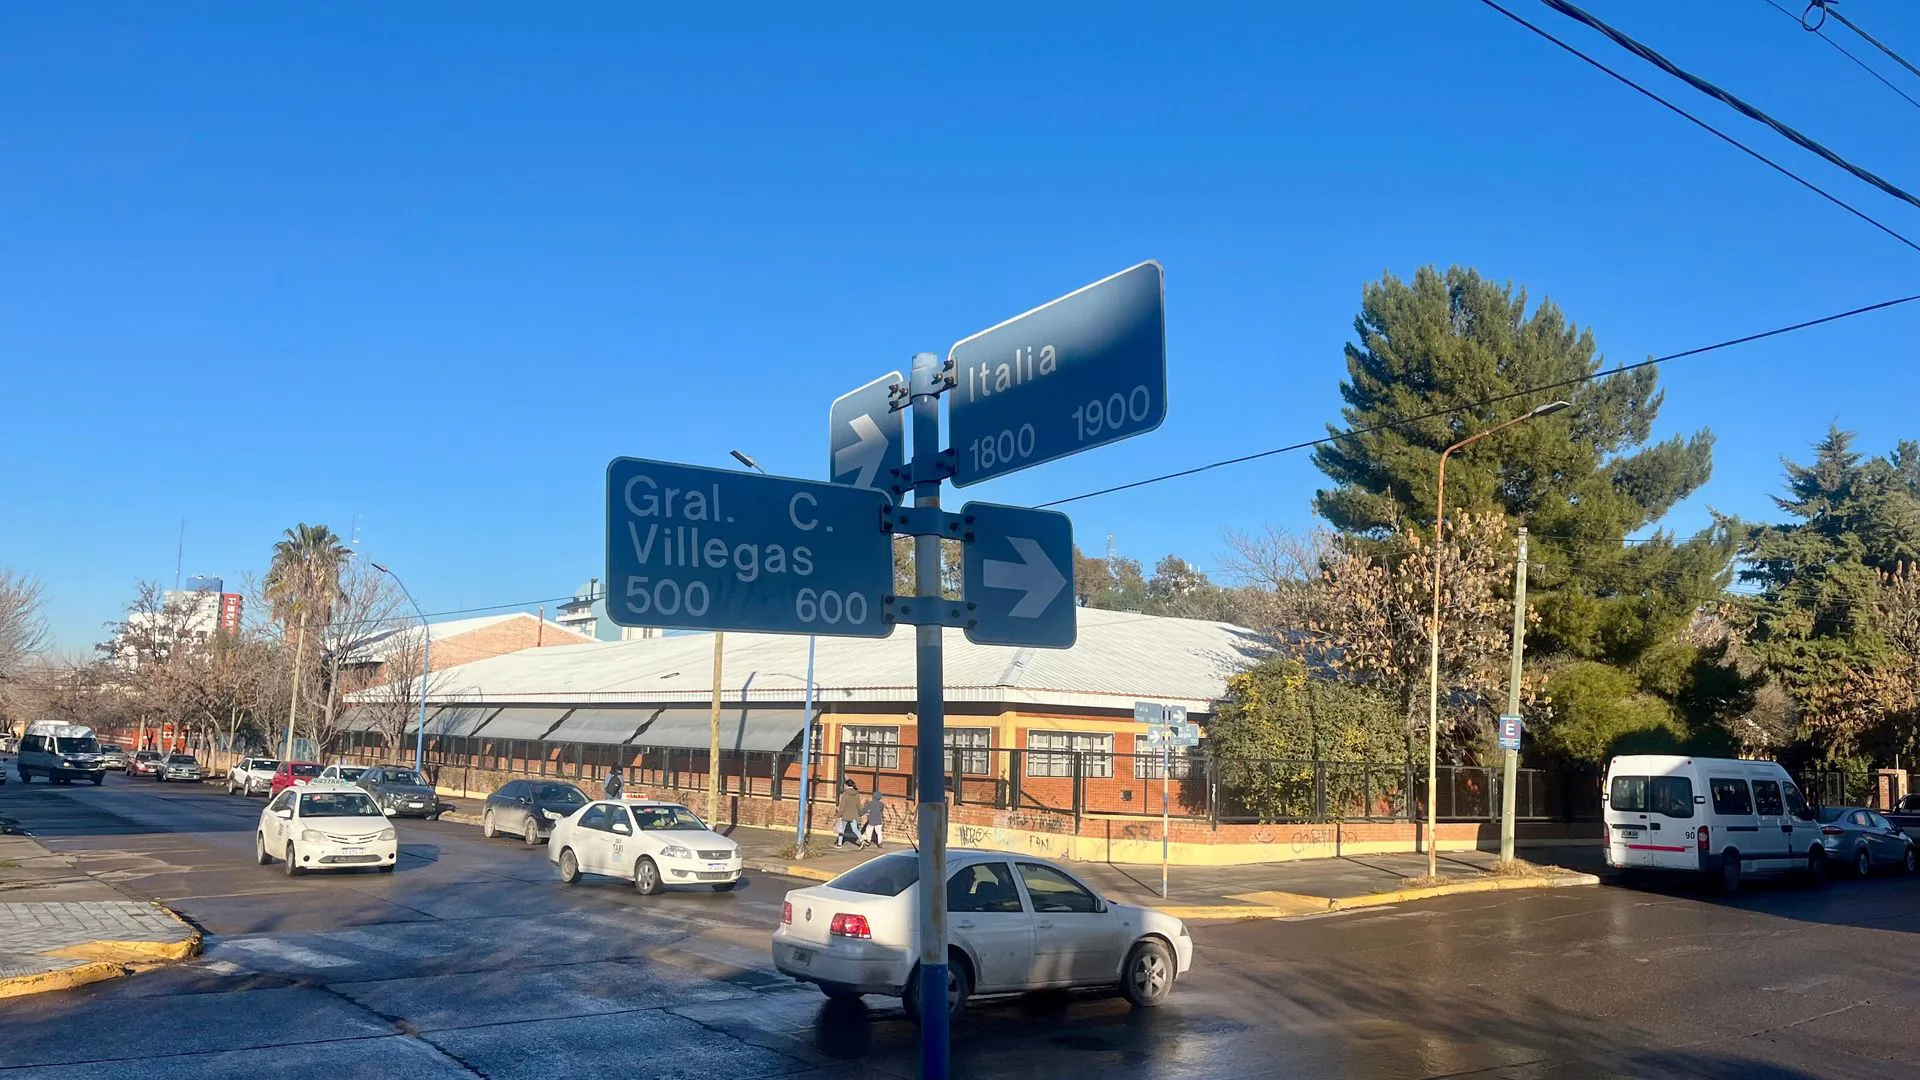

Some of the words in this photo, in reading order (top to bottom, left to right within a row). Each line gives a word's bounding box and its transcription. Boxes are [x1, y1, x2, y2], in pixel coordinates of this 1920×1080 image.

[968, 342, 1057, 403] Italia
[969, 423, 1036, 472] 1800
[1071, 384, 1150, 441] 1900
[625, 475, 734, 524] Gral.
[789, 492, 834, 533] C.
[627, 521, 814, 582] Villegas
[626, 576, 710, 617] 500
[796, 587, 867, 626] 600
[1505, 723, 1515, 736] E
[1685, 831, 1696, 840] 90
